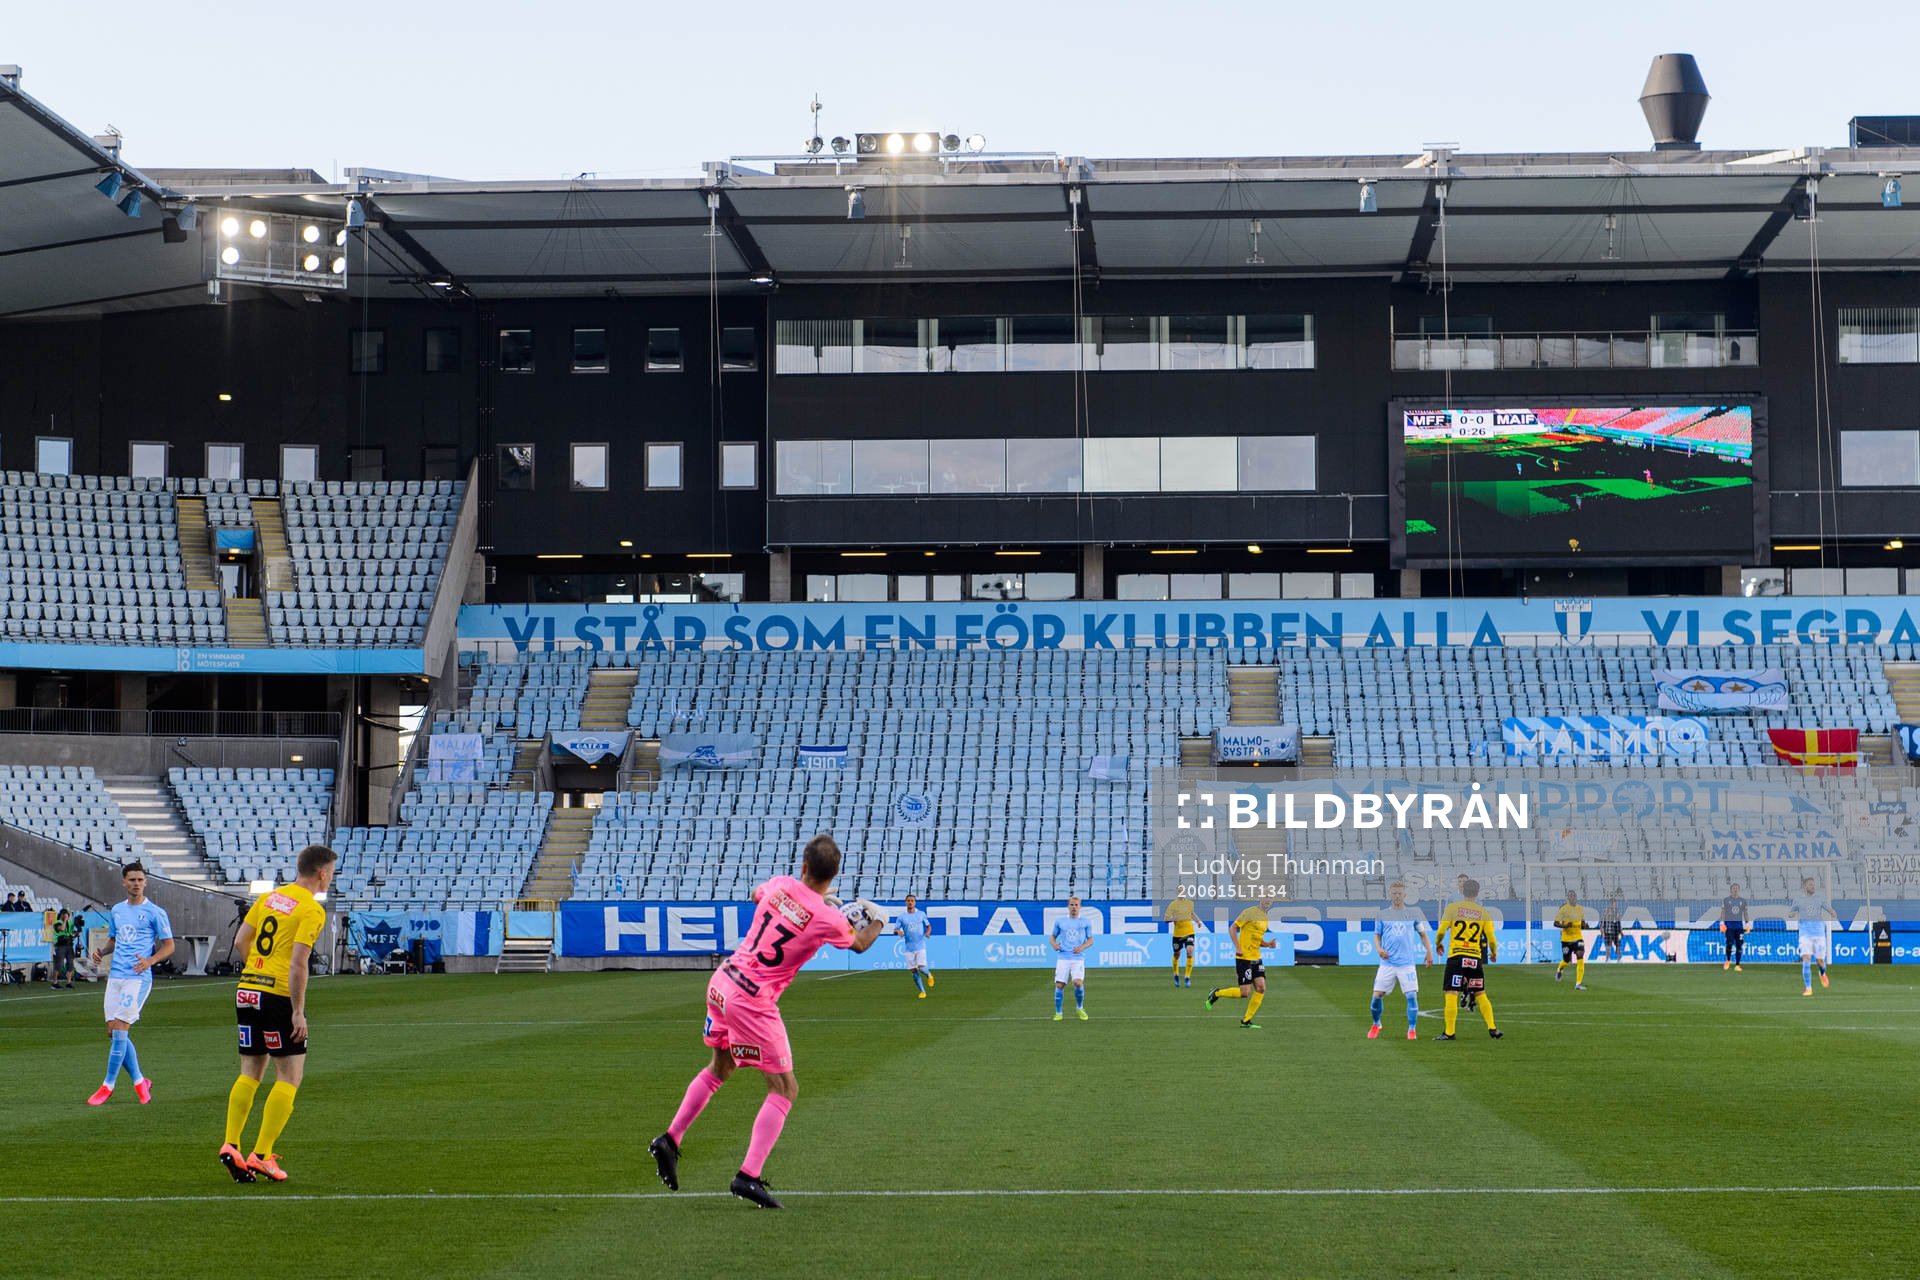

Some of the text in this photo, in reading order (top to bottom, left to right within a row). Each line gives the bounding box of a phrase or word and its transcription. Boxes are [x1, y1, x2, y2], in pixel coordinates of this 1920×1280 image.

[1459, 415, 1484, 425] 0-0
[1496, 415, 1535, 426] MAIF
[503, 616, 556, 651] VI
[574, 605, 707, 652] STÅR
[724, 614, 845, 652] SOM
[865, 614, 935, 651] EN
[955, 603, 1066, 650] FÖR
[1084, 613, 1343, 650] KLUBBEN
[1365, 611, 1503, 647] ALLA
[1640, 610, 1700, 646] VI
[1513, 716, 1664, 756] MALMÖ
[1711, 838, 1842, 859] MÄSTARNA
[256, 916, 278, 956] 8
[367, 934, 398, 944] MFF
[749, 911, 798, 967] 13
[1454, 920, 1480, 943] 22
[1006, 942, 1046, 956] bemt
[1098, 951, 1143, 965] PUMA
[1587, 934, 1668, 961] AAK
[1742, 942, 1772, 955] first
[1835, 941, 1857, 957] for
